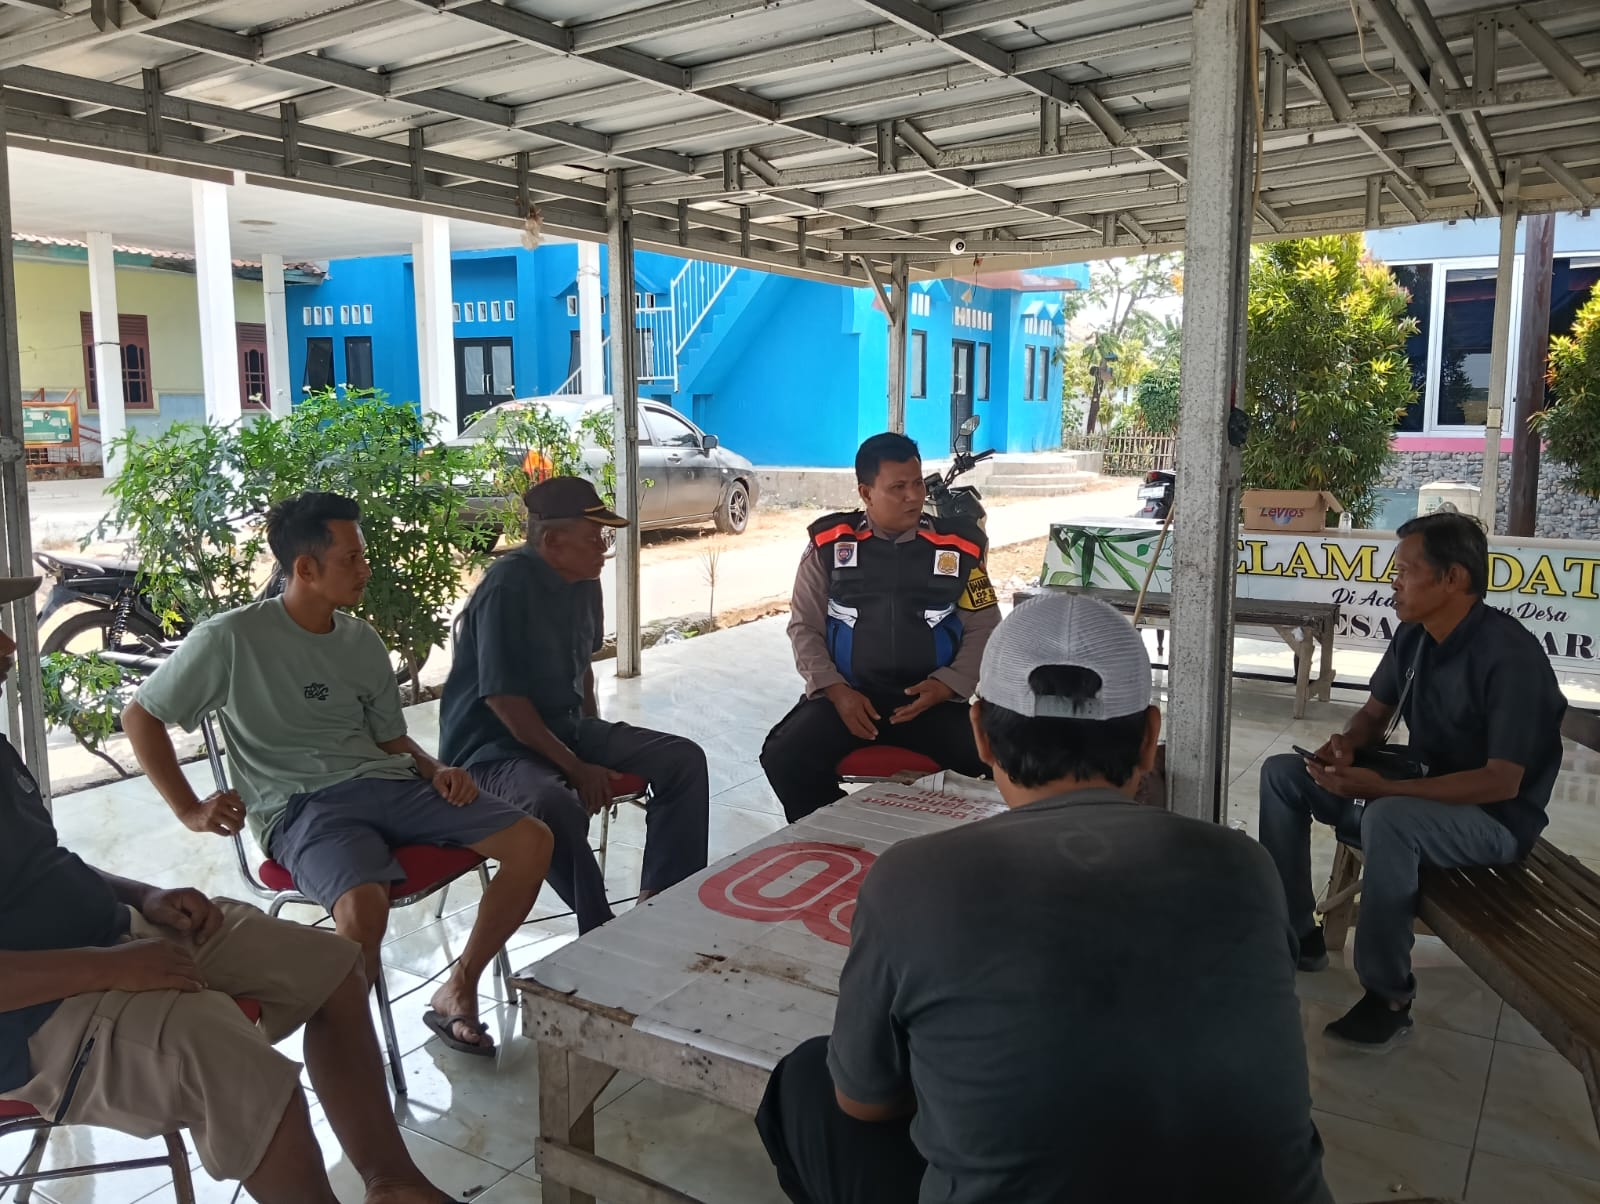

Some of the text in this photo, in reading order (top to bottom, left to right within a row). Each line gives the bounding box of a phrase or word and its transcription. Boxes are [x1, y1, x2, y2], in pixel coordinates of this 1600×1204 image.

[1236, 540, 1400, 584] LAM
[1331, 587, 1357, 605] Di
[1516, 602, 1568, 622] Desa
[862, 797, 968, 819] Berdaulat
